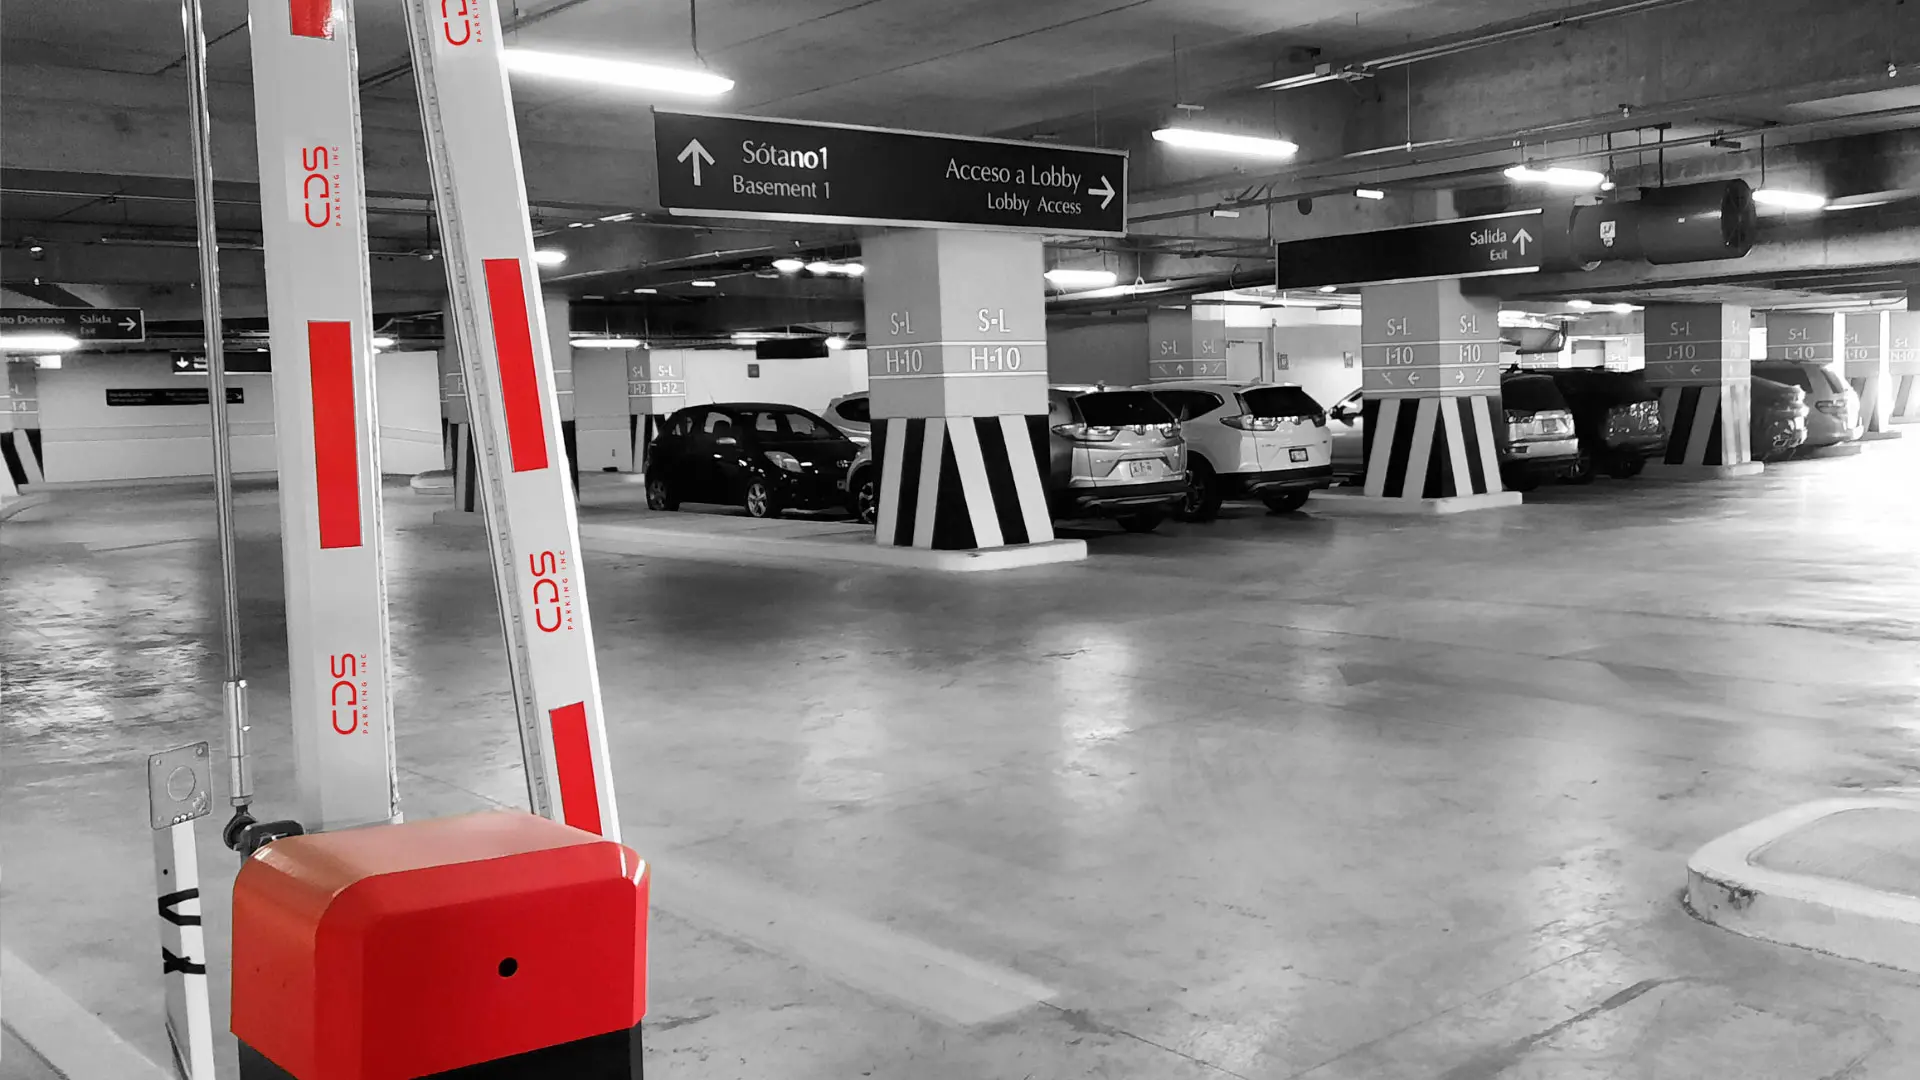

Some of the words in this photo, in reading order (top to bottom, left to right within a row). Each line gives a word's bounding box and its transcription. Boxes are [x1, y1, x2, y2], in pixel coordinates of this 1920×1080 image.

[441, 0, 471, 46] CD
[331, 146, 340, 166] INC
[302, 146, 330, 228] CDS
[732, 175, 818, 199] Basement
[823, 181, 831, 199] 1
[945, 158, 1010, 185] Acceso
[1015, 170, 1026, 185] a
[1031, 164, 1083, 189] Lobby
[333, 174, 342, 227] PARKING
[987, 192, 1030, 216] Lobby
[1037, 195, 1082, 215] Access
[1470, 228, 1507, 246] Salida
[1490, 249, 1508, 261] Exit
[79, 313, 113, 324] Salida
[559, 550, 567, 570] INC
[529, 551, 562, 633] CDS
[562, 578, 575, 630] PARKING
[331, 653, 358, 735] CDS
[361, 681, 369, 734] PARKING
